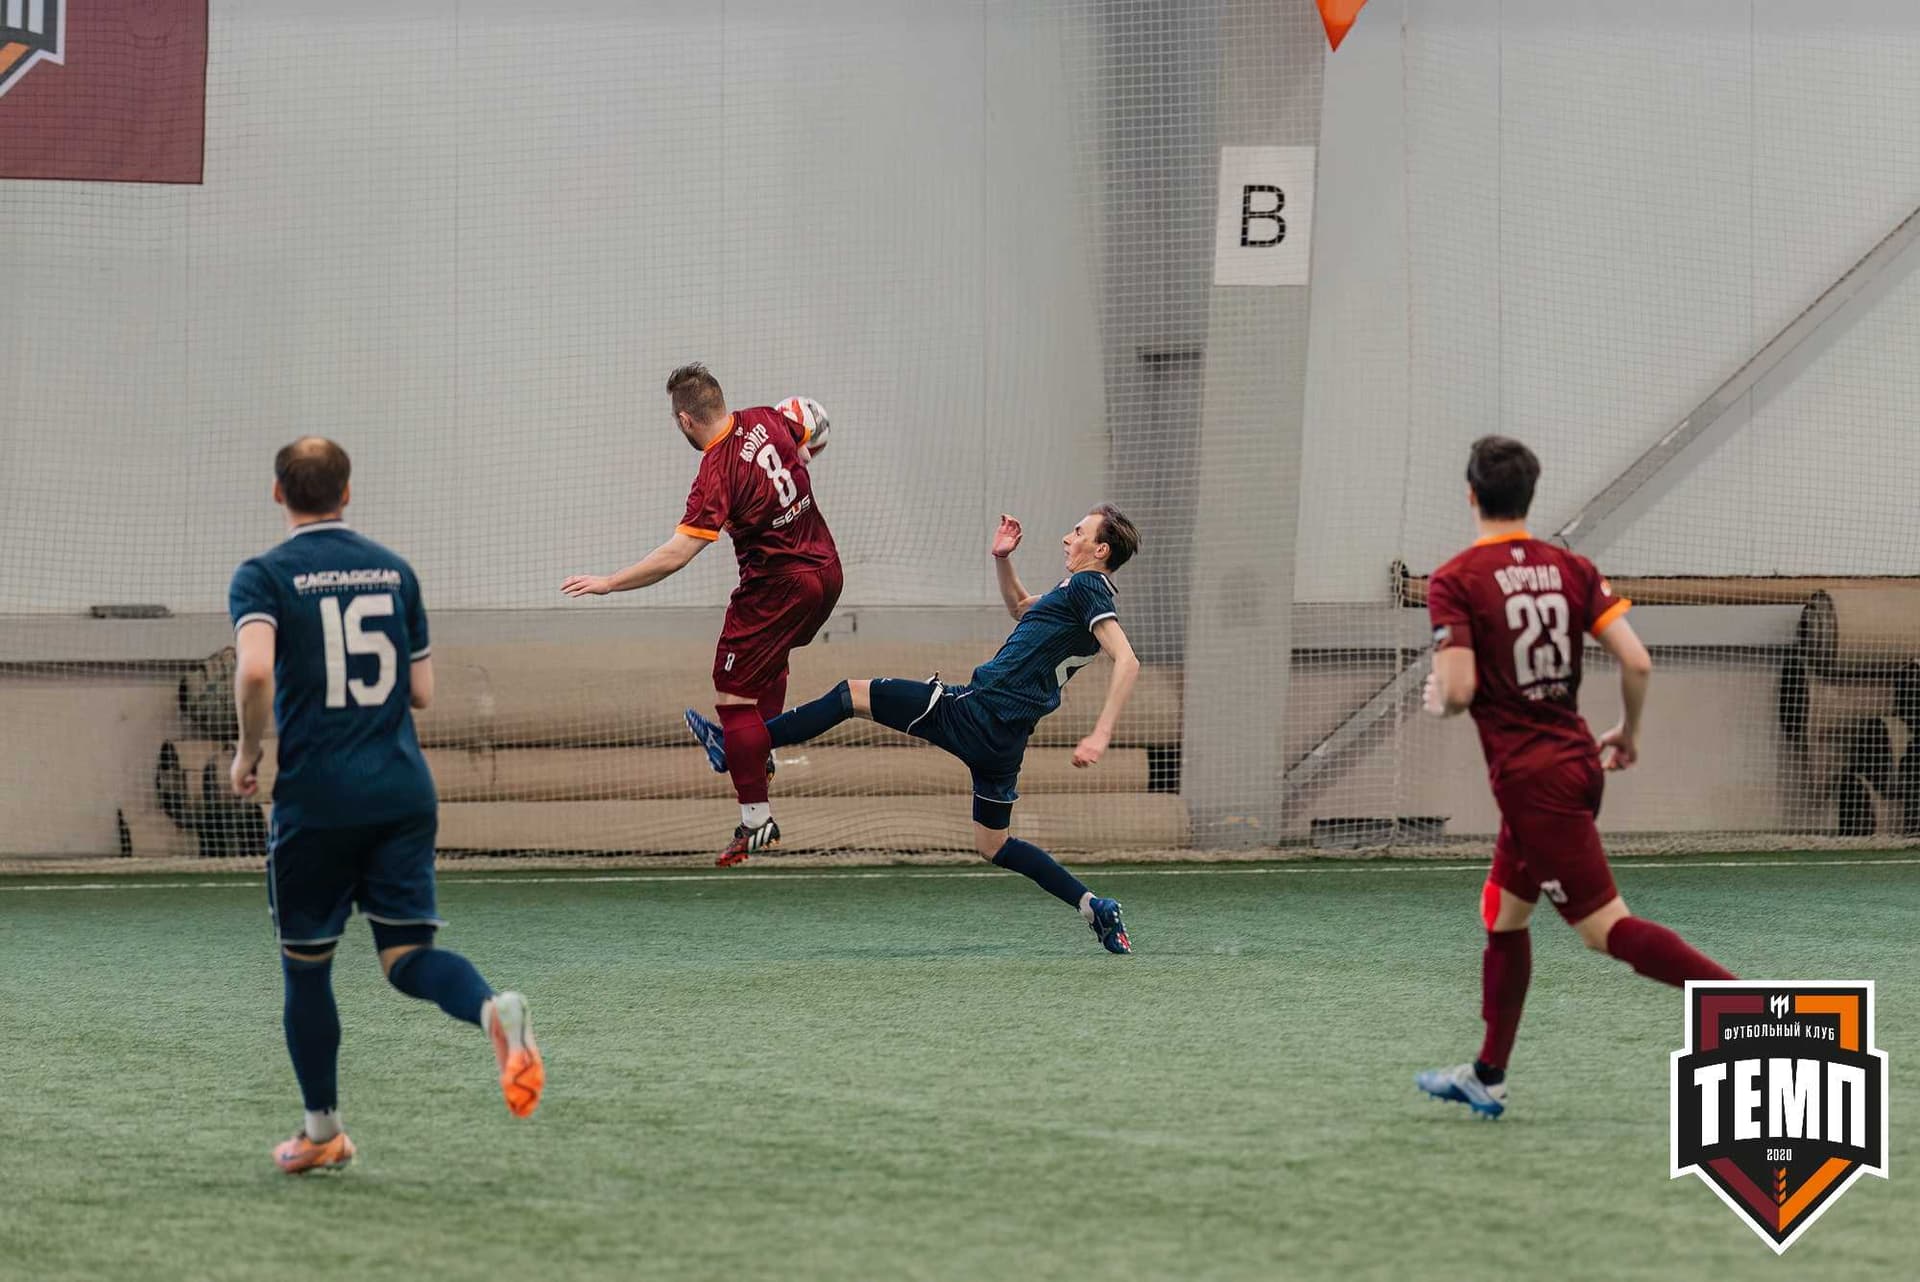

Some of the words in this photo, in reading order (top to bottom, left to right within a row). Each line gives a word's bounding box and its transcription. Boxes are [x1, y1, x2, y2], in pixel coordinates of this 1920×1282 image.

[756, 443, 798, 508] 8
[319, 593, 398, 708] 15
[1505, 592, 1572, 687] 23
